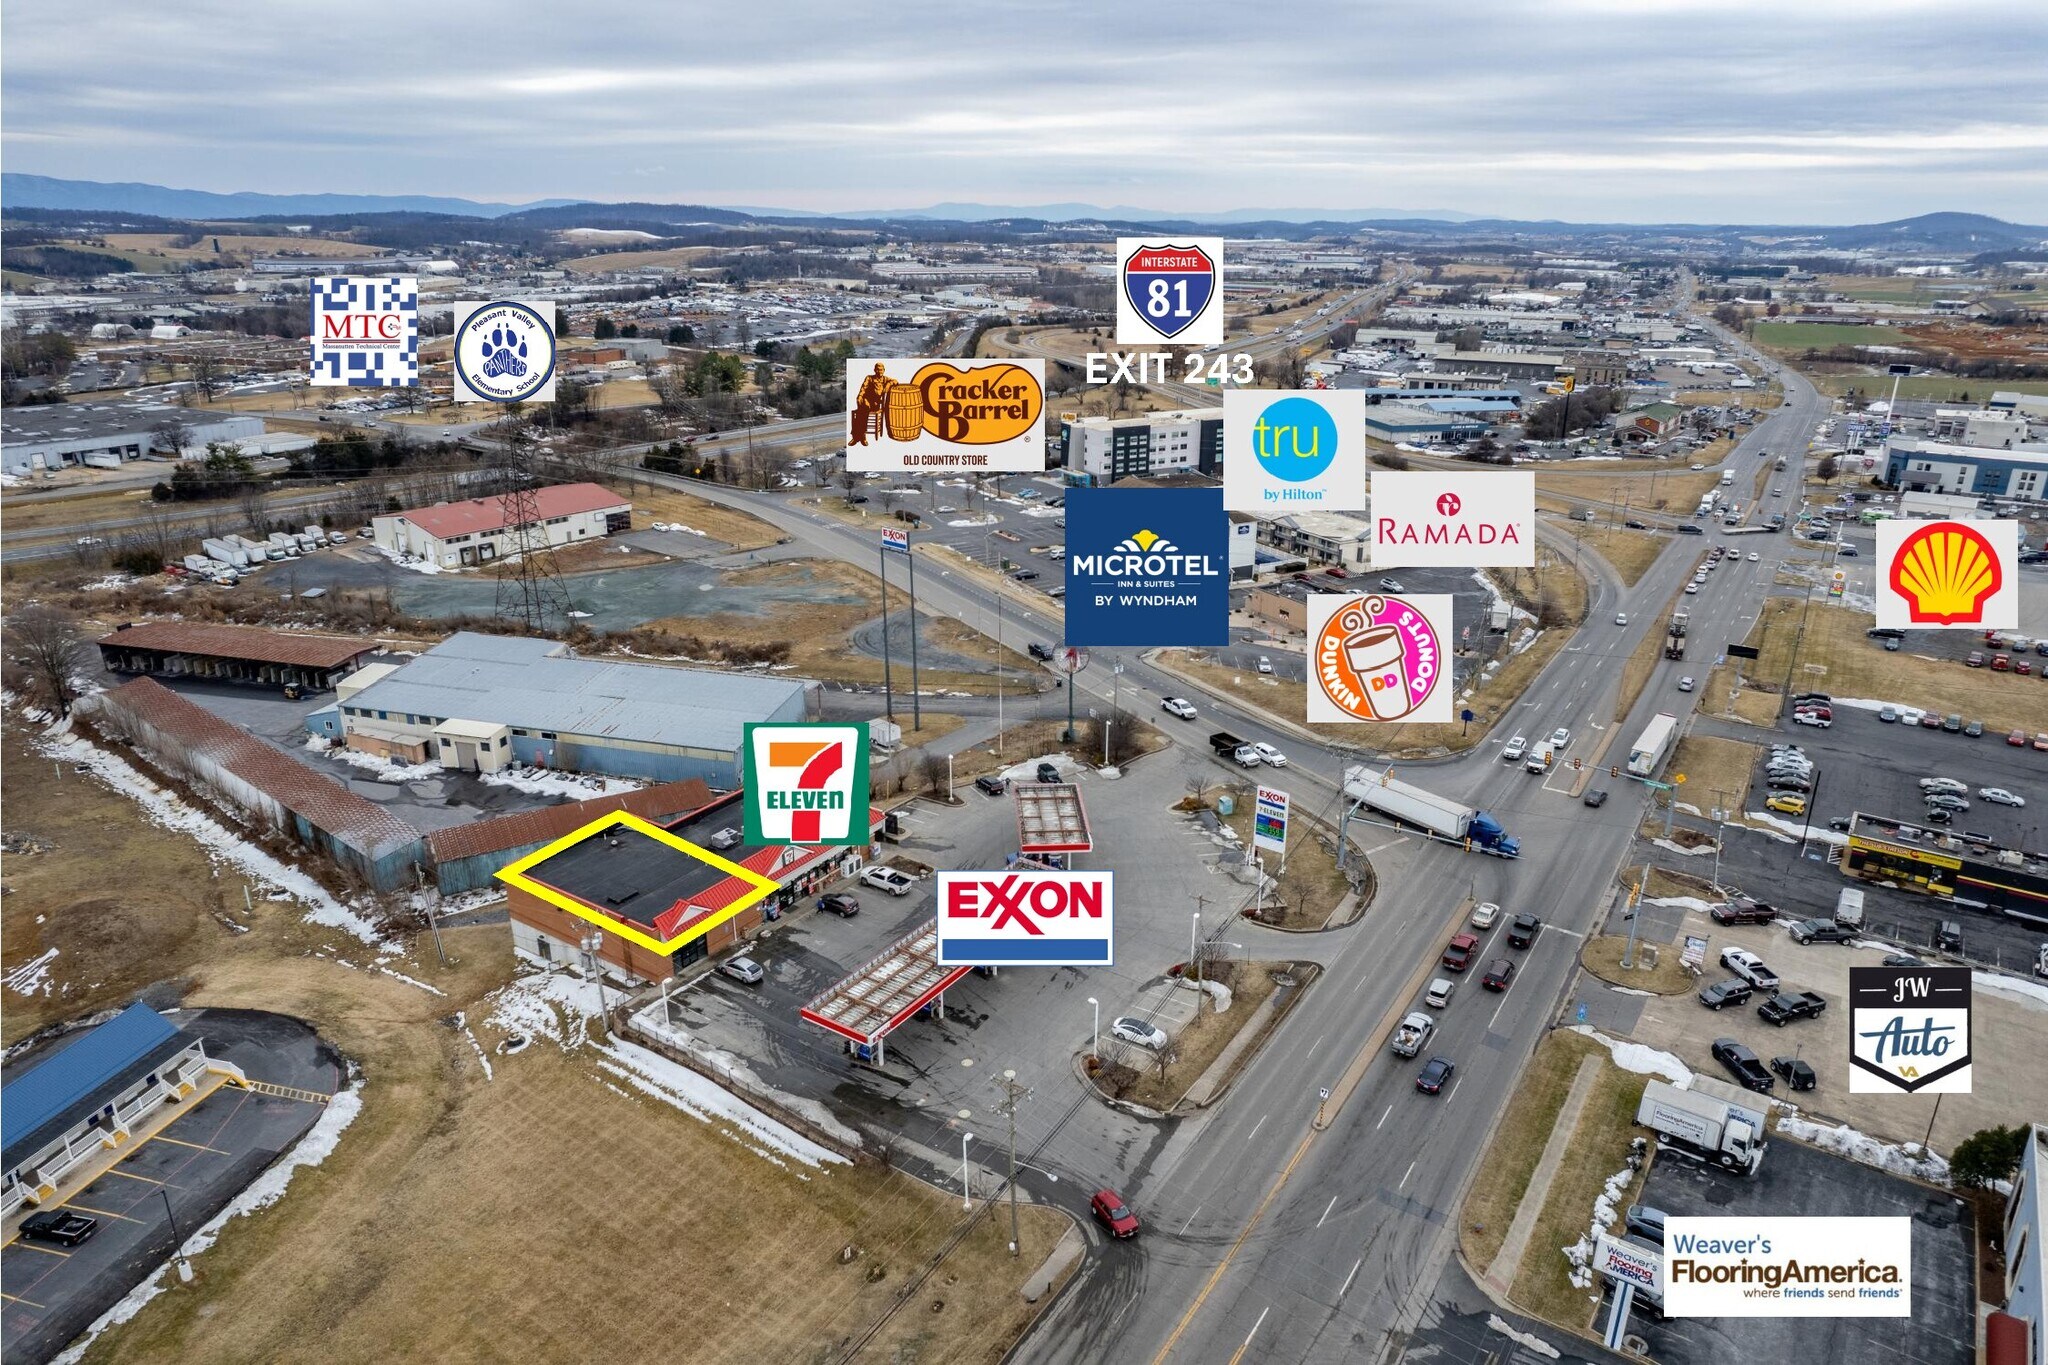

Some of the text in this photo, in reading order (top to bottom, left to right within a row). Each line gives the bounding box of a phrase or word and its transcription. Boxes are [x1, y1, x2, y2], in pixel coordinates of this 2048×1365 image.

[883, 528, 906, 541] EXXON
[1259, 789, 1286, 803] EXXON
[1606, 1245, 1658, 1272] Weaver's
[1609, 1254, 1653, 1280] Flooring
[1605, 1261, 1655, 1287] AMERICA
